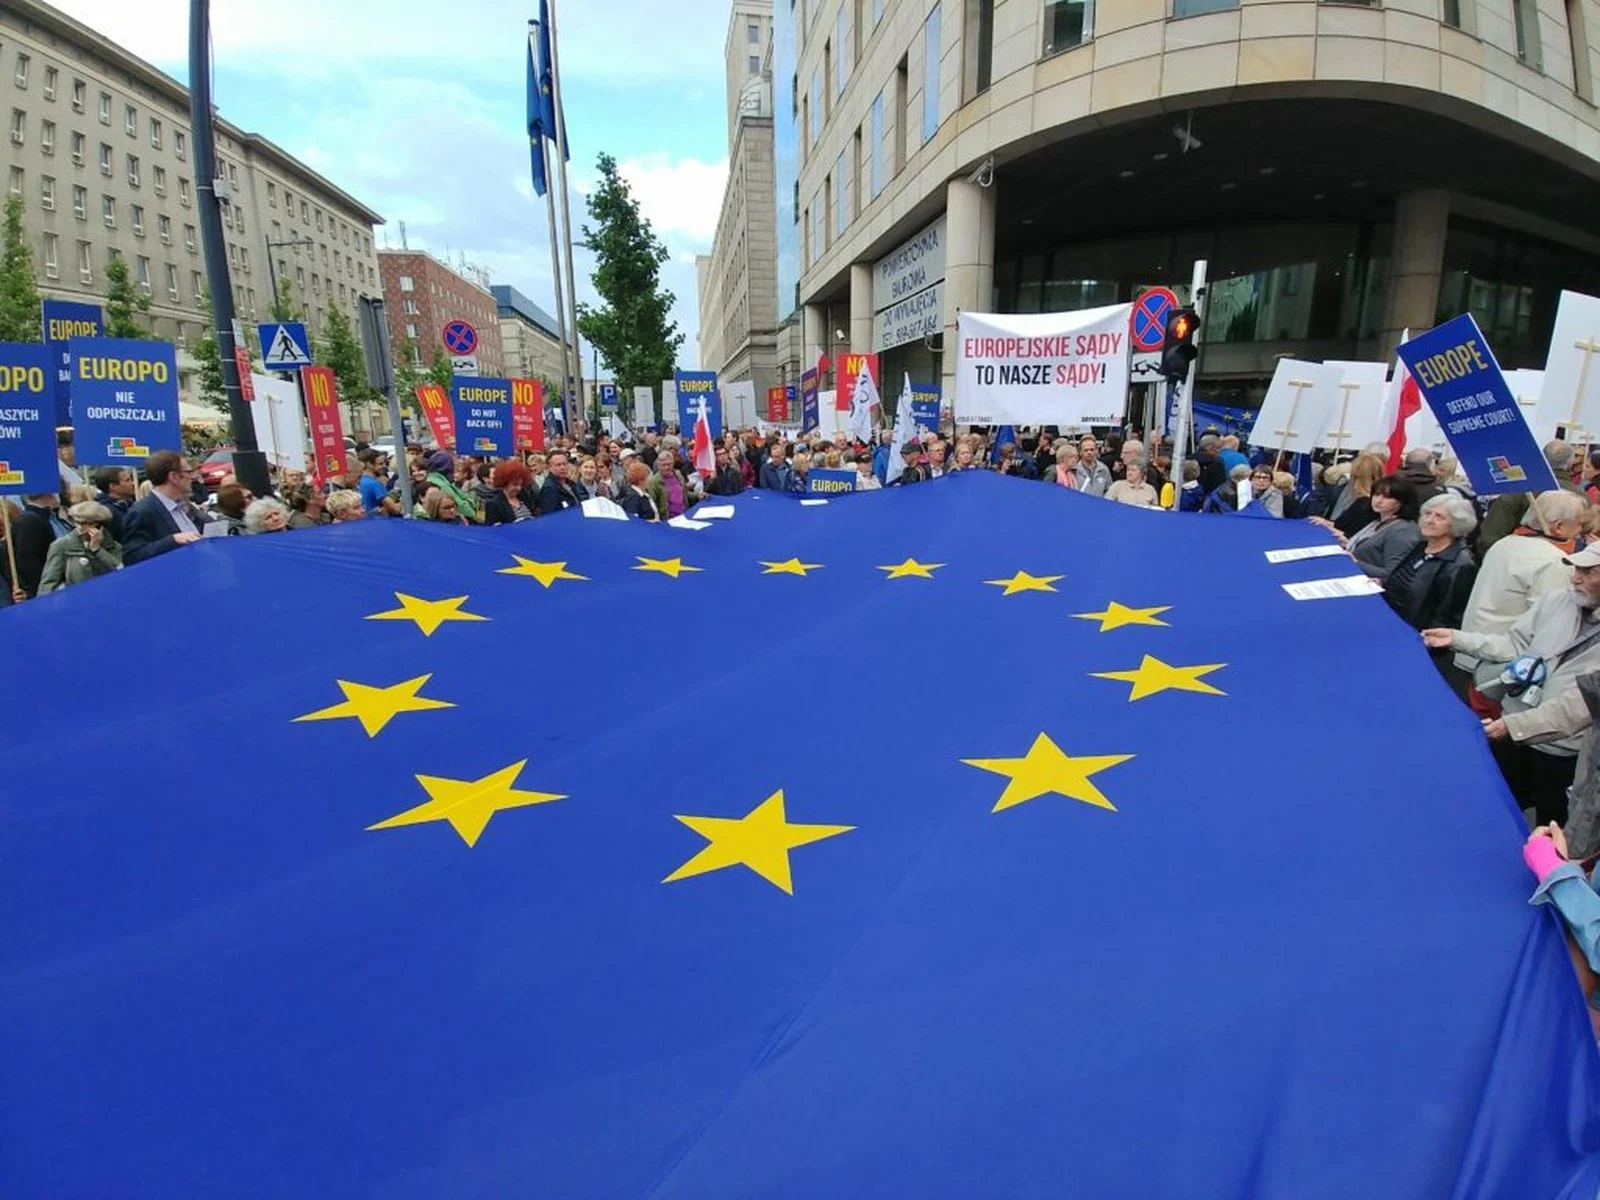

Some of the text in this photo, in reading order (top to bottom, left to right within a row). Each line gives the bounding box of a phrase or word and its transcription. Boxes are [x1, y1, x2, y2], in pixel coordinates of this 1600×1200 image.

[965, 333, 1122, 359] EUROPEJSKIE SĄDY
[79, 357, 168, 383] EUROPO
[975, 363, 1106, 388] TO NASZE SĄDY!
[1414, 340, 1489, 389] EUROPE
[115, 391, 135, 403] NIE
[310, 373, 331, 408] NO
[459, 387, 507, 404] EUROPE
[512, 382, 533, 405] NO
[604, 386, 615, 399] P
[680, 381, 714, 392] EUROPE
[423, 389, 443, 409] NO
[1446, 390, 1497, 415] DEFEND OUR
[87, 407, 165, 421] ODPUSZCZAJ!
[1448, 408, 1517, 434] SUPREME COURT!
[811, 479, 853, 492] EUROPO
